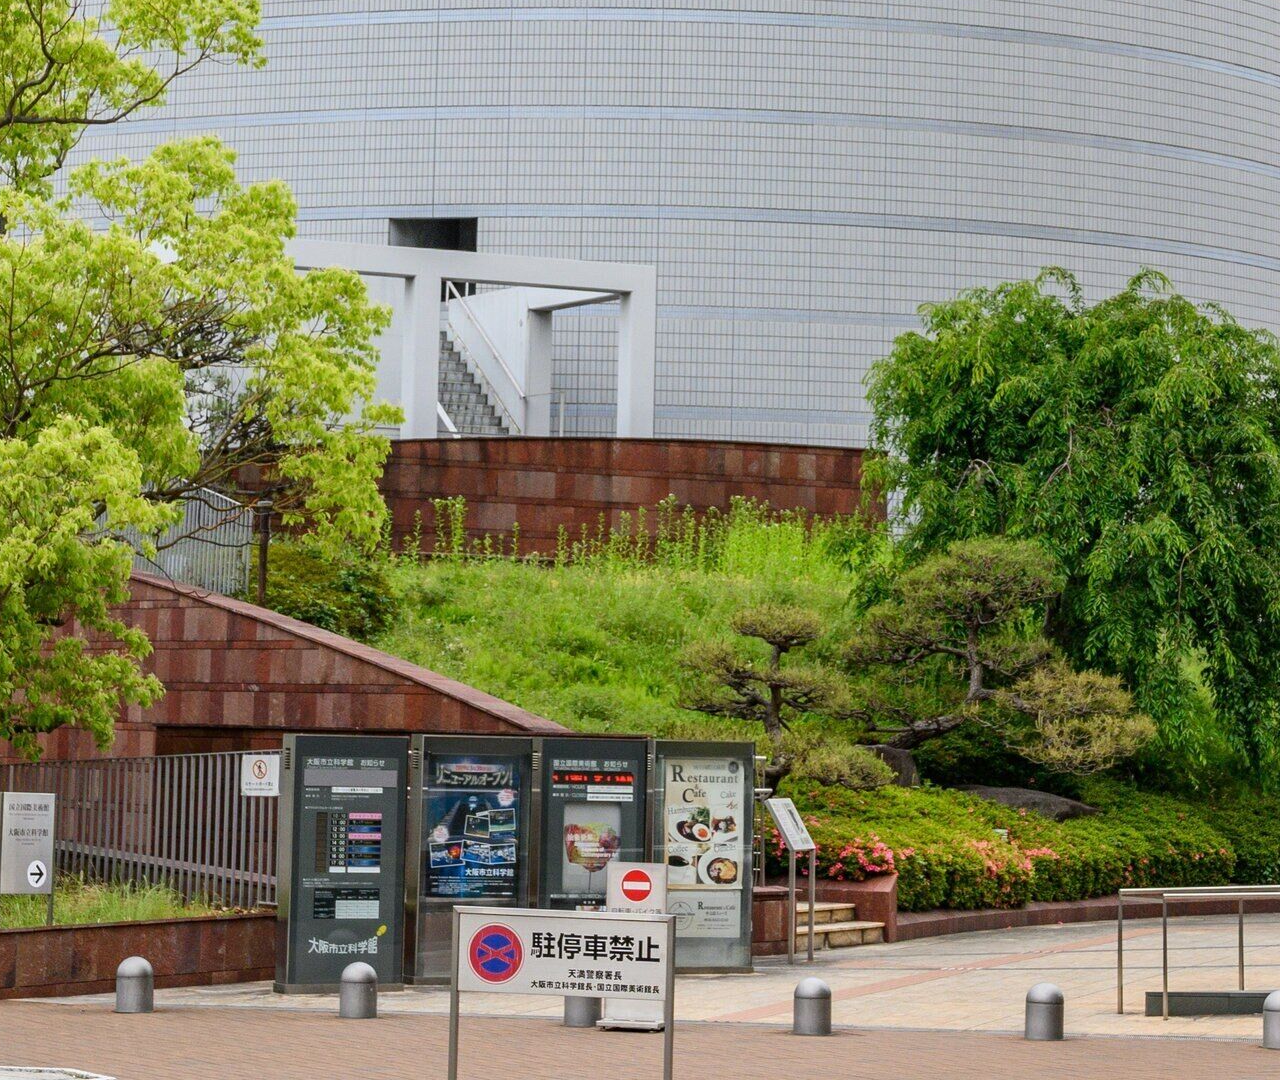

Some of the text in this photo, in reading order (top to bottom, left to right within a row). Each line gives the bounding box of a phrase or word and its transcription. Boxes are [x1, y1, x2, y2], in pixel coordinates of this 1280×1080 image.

[307, 758, 385, 767] 大阪市立科学館 お知らせ
[671, 764, 739, 784] Restaurant
[682, 788, 707, 803] Cafe
[465, 868, 514, 877] 大阪市立科学館
[308, 936, 378, 954] 大阪市立科学館
[531, 932, 661, 963] 駐停車禁止
[568, 969, 622, 981] 天満警察署長
[531, 981, 660, 994] 大阪市立科学館長・国立国際美術館長
